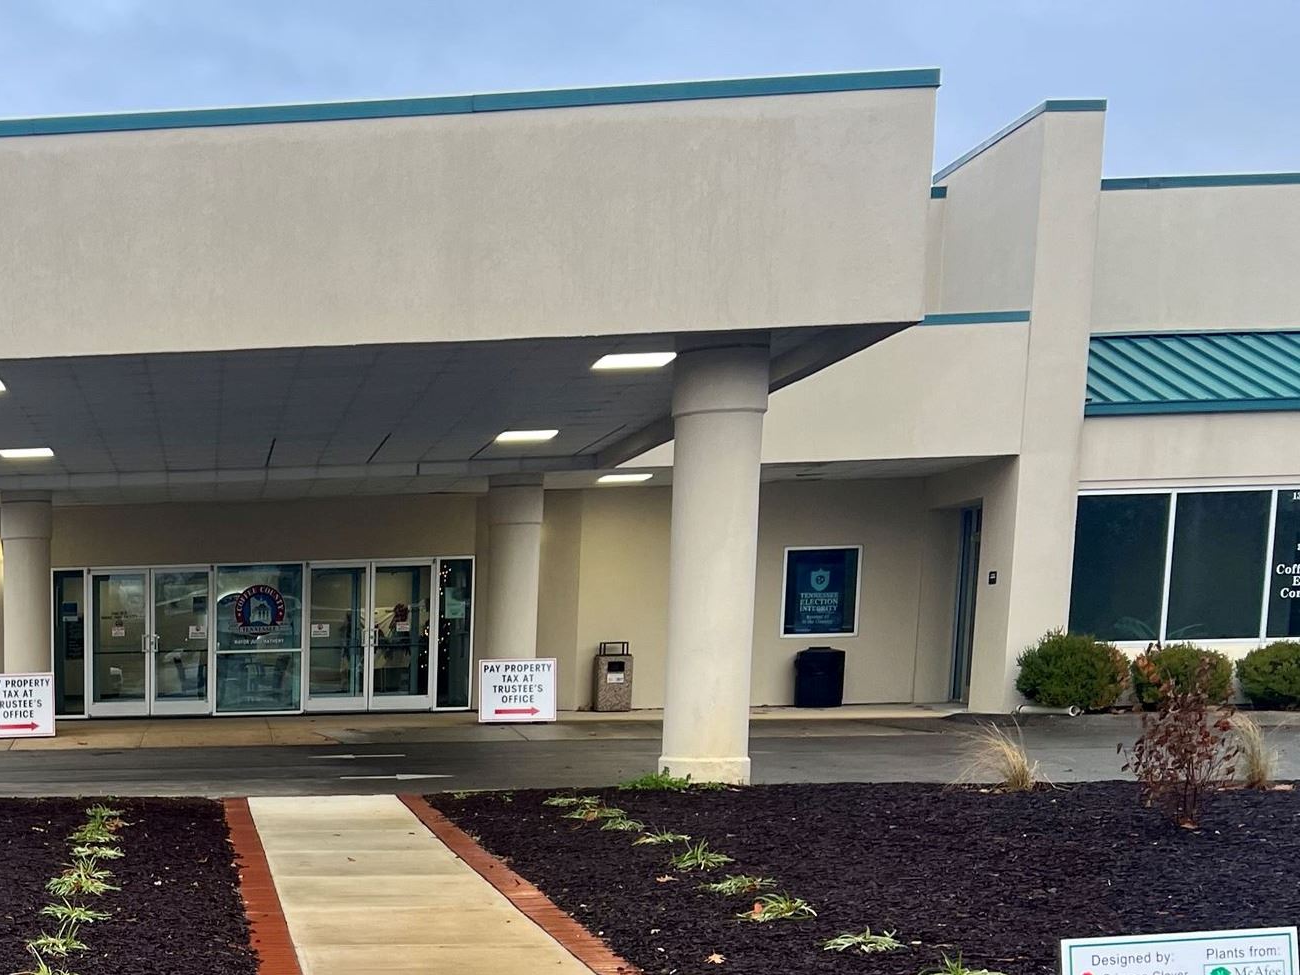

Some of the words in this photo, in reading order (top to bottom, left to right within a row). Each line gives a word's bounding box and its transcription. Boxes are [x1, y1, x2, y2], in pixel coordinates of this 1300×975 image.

[484, 664, 500, 673] PAY
[504, 664, 552, 672] PROPERTY
[502, 674, 518, 682] TAX
[523, 674, 534, 682] AT
[6, 679, 50, 688] PROPERTY
[493, 684, 544, 693] TRUSTEE'S
[3, 690, 19, 698] TAX
[23, 690, 33, 698] AT
[502, 695, 534, 703] OFFICE
[3, 710, 34, 719] OFFICE
[1206, 947, 1244, 960] Plants
[1250, 946, 1281, 958] from:
[1092, 952, 1151, 966] Designed
[1156, 951, 1174, 963] by:
